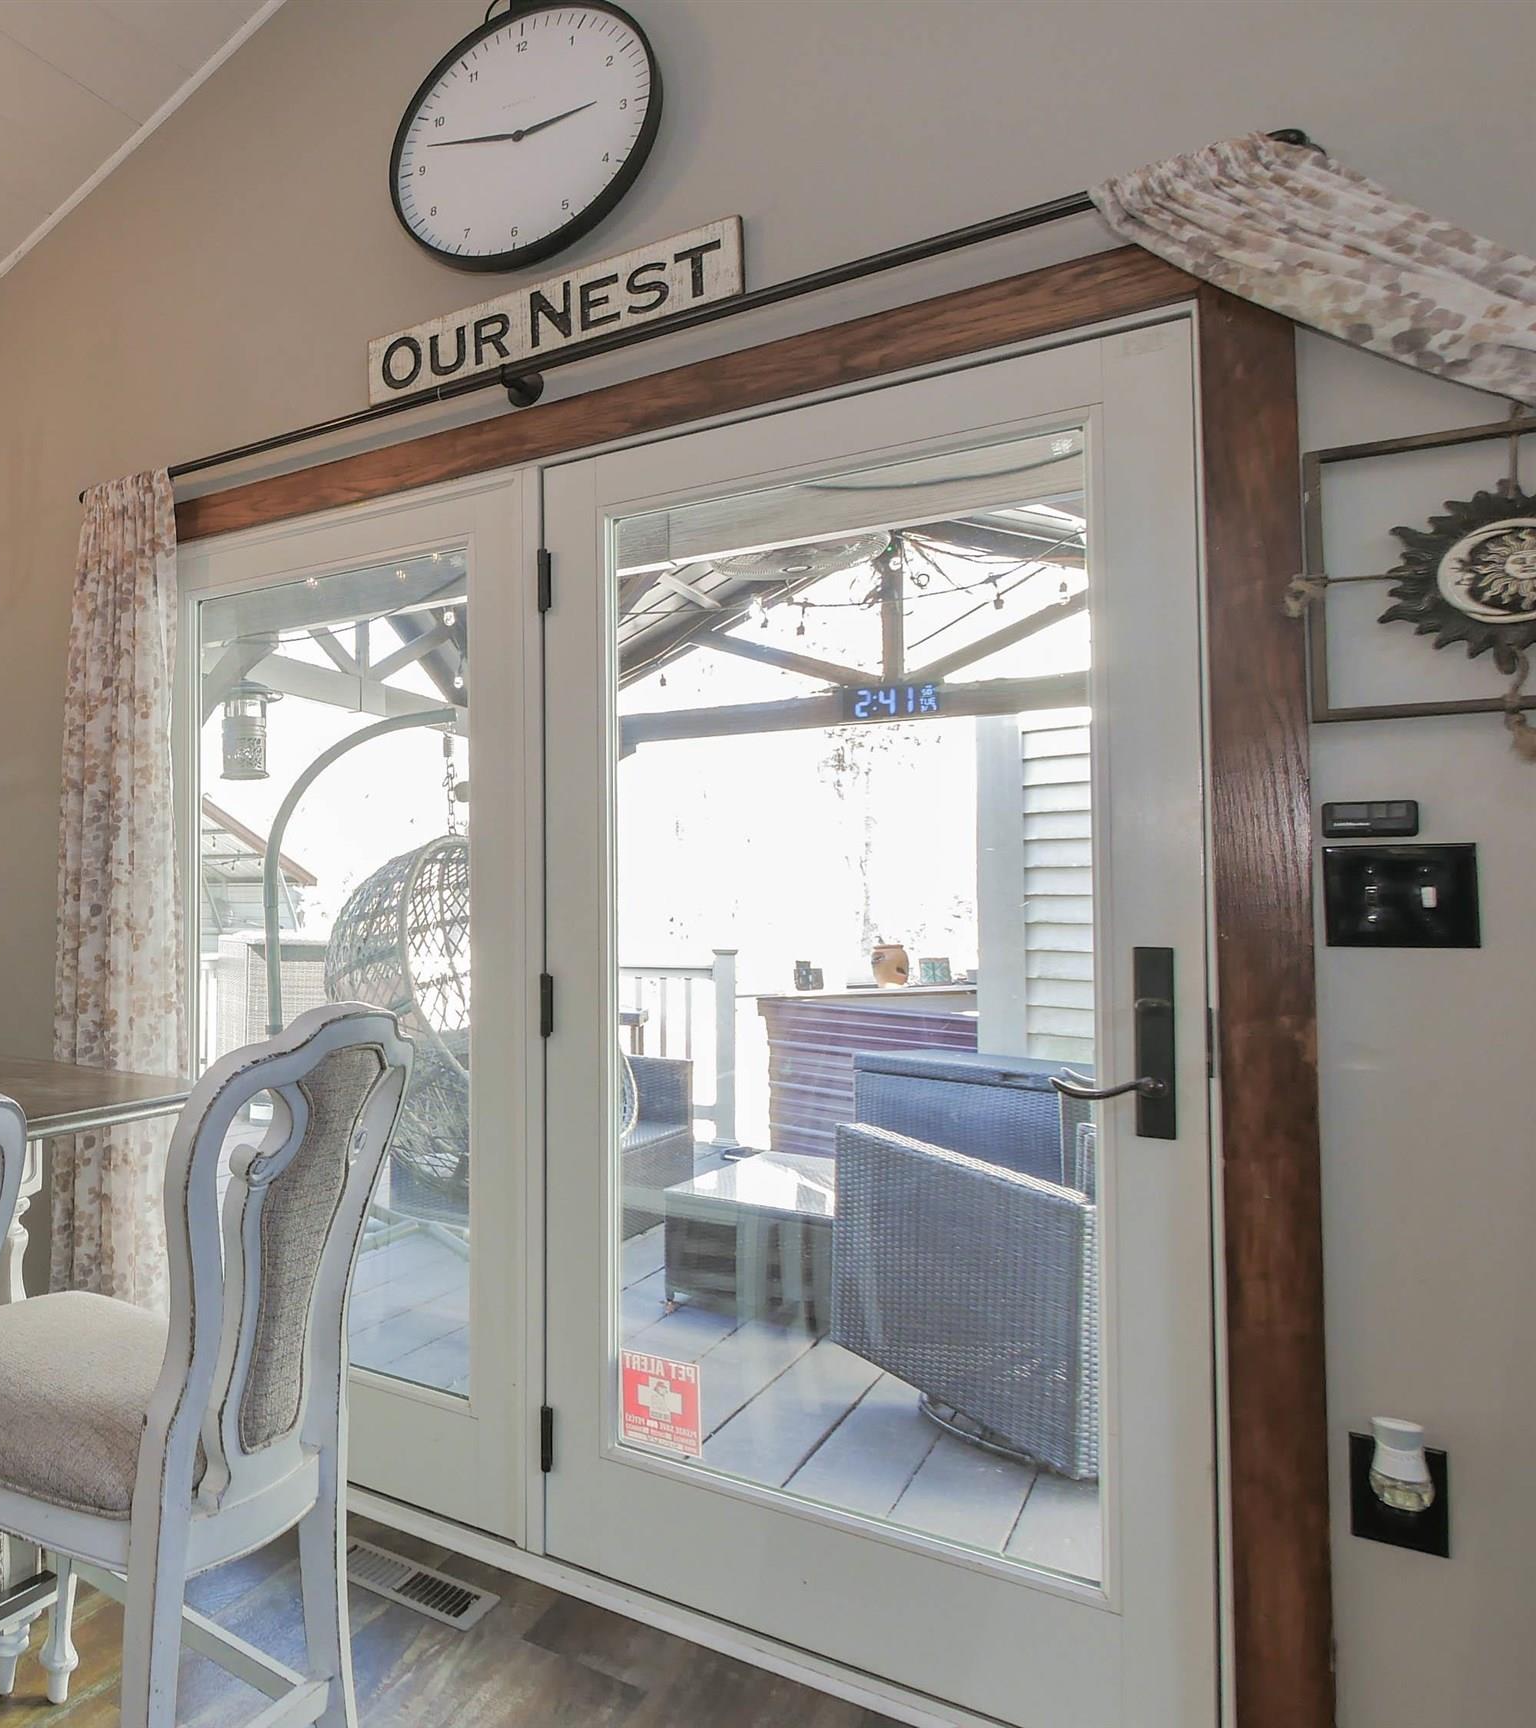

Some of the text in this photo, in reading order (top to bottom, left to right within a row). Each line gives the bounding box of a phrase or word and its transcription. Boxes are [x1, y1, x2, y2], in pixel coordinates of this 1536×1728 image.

[515, 41, 528, 53] 12
[605, 55, 614, 67] 2
[467, 71, 479, 83] 11
[619, 98, 628, 110] 3
[434, 116, 445, 128] 10
[602, 152, 610, 164] 4
[418, 166, 426, 176] 9
[561, 199, 569, 210] 5
[430, 206, 437, 217] 8
[463, 228, 471, 239] 7
[510, 226, 518, 237] 6
[382, 238, 721, 390] OUR NEST
[855, 687, 914, 717] 2:41
